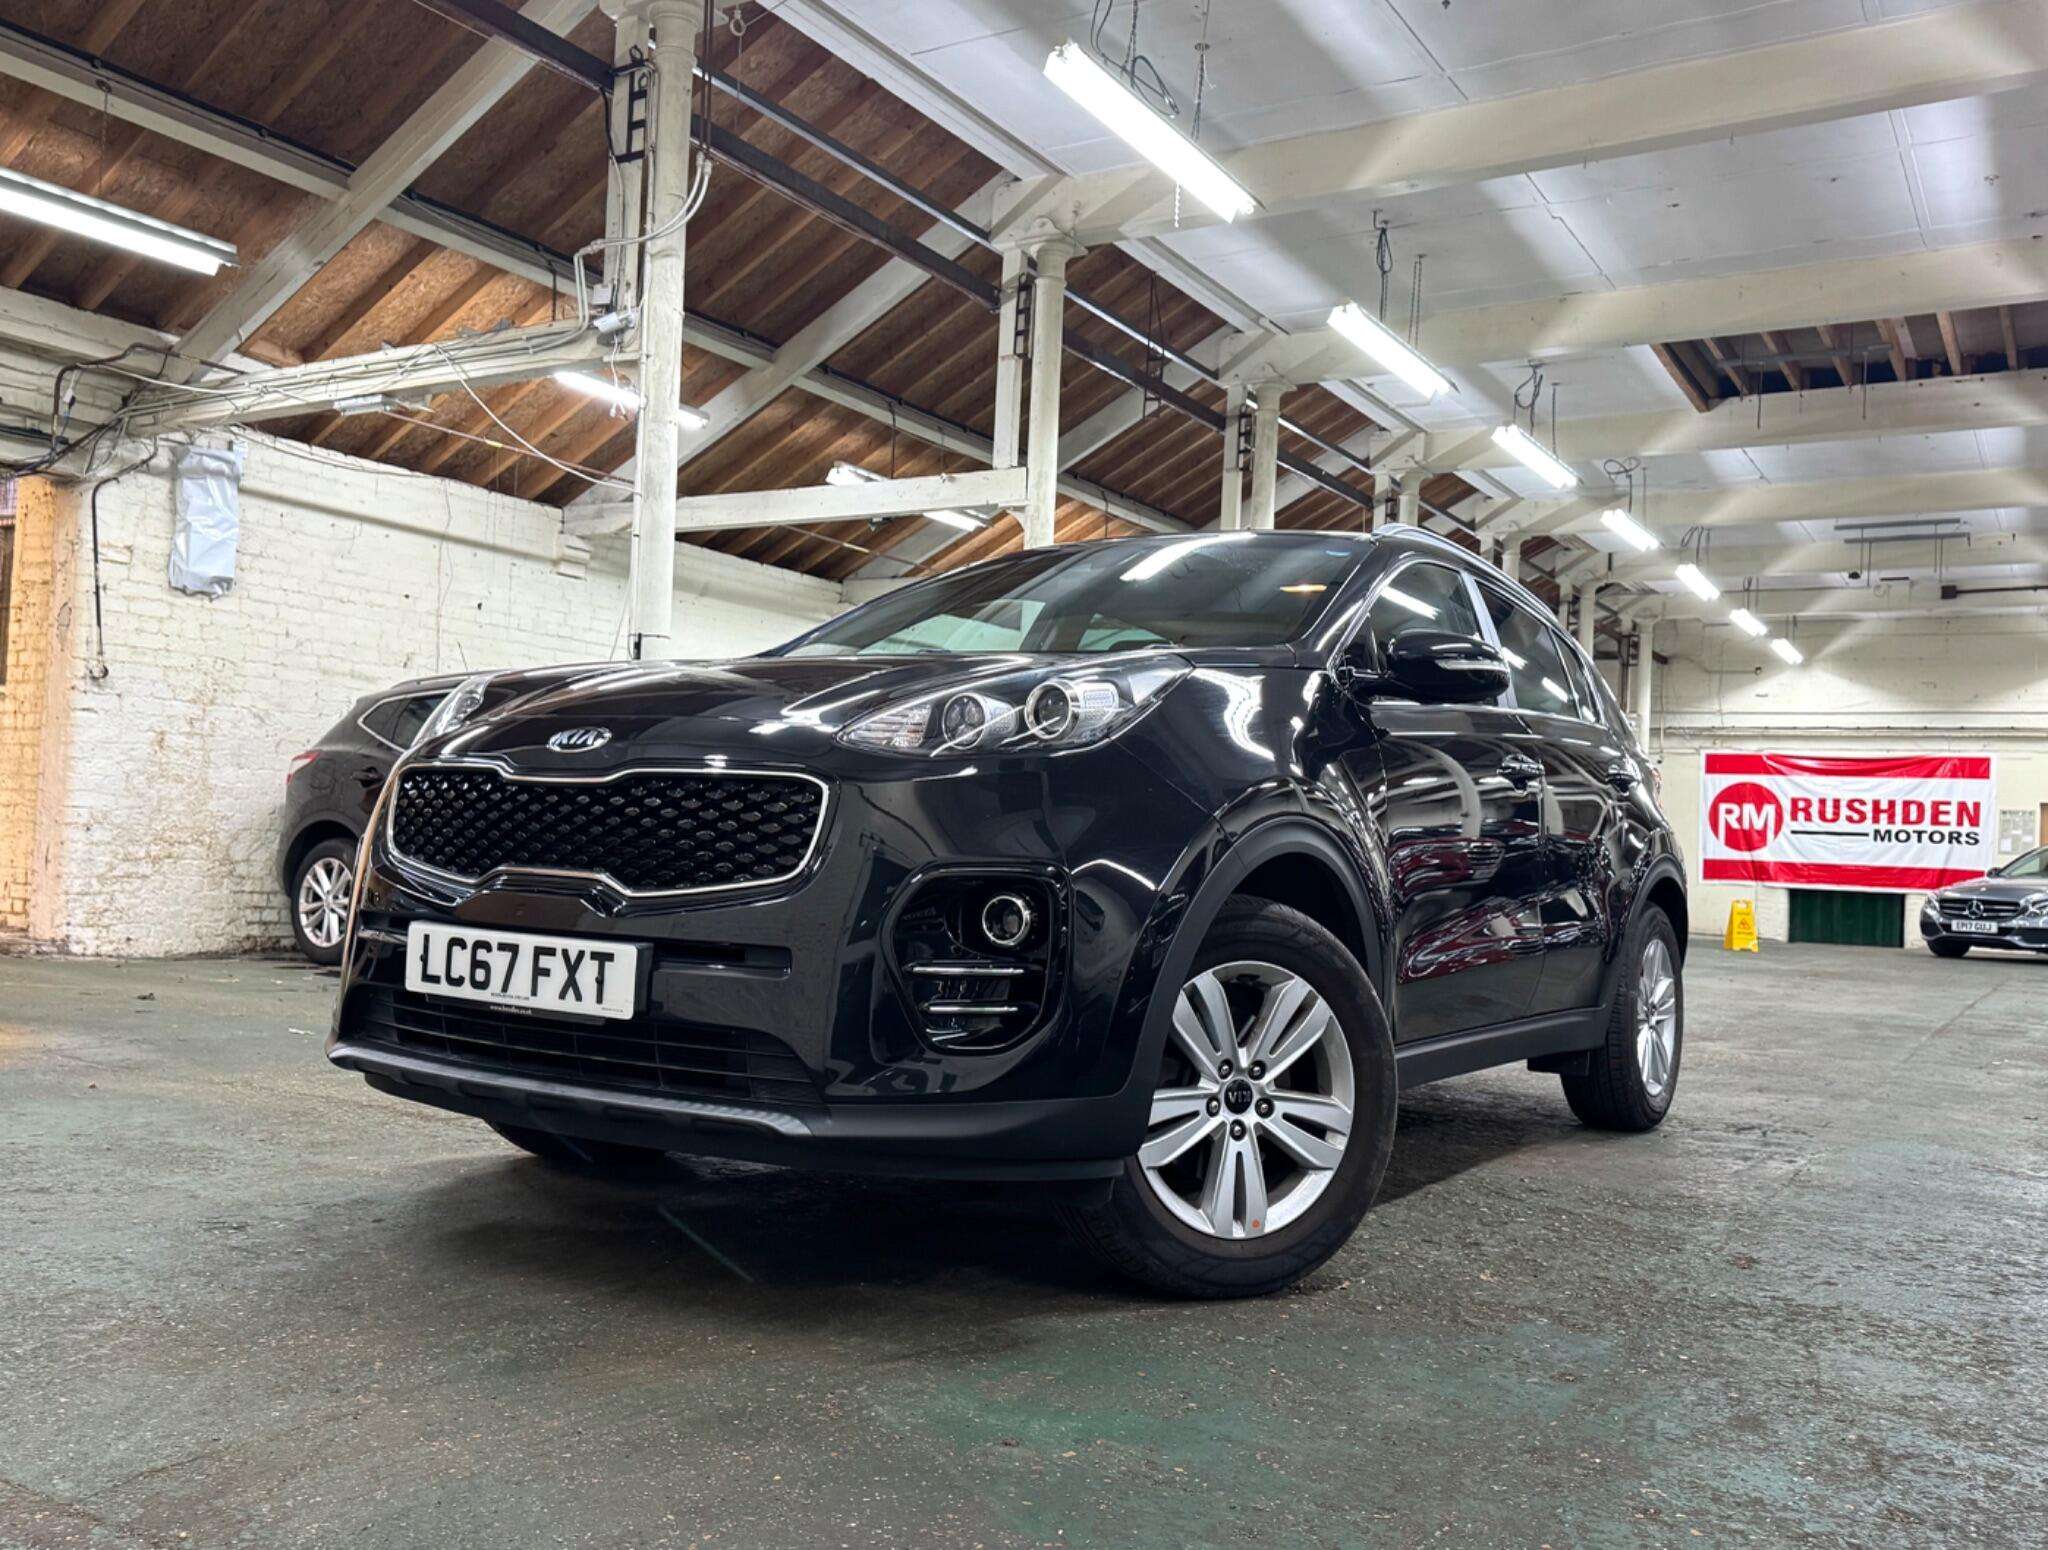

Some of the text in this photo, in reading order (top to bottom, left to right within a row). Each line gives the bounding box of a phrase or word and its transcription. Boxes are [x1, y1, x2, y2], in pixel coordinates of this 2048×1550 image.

[1718, 802, 1776, 846] RM
[1789, 797, 1981, 828] RUSHDEN
[1872, 828, 1981, 846] MOTORS
[420, 934, 615, 1004] LC67 FXT
